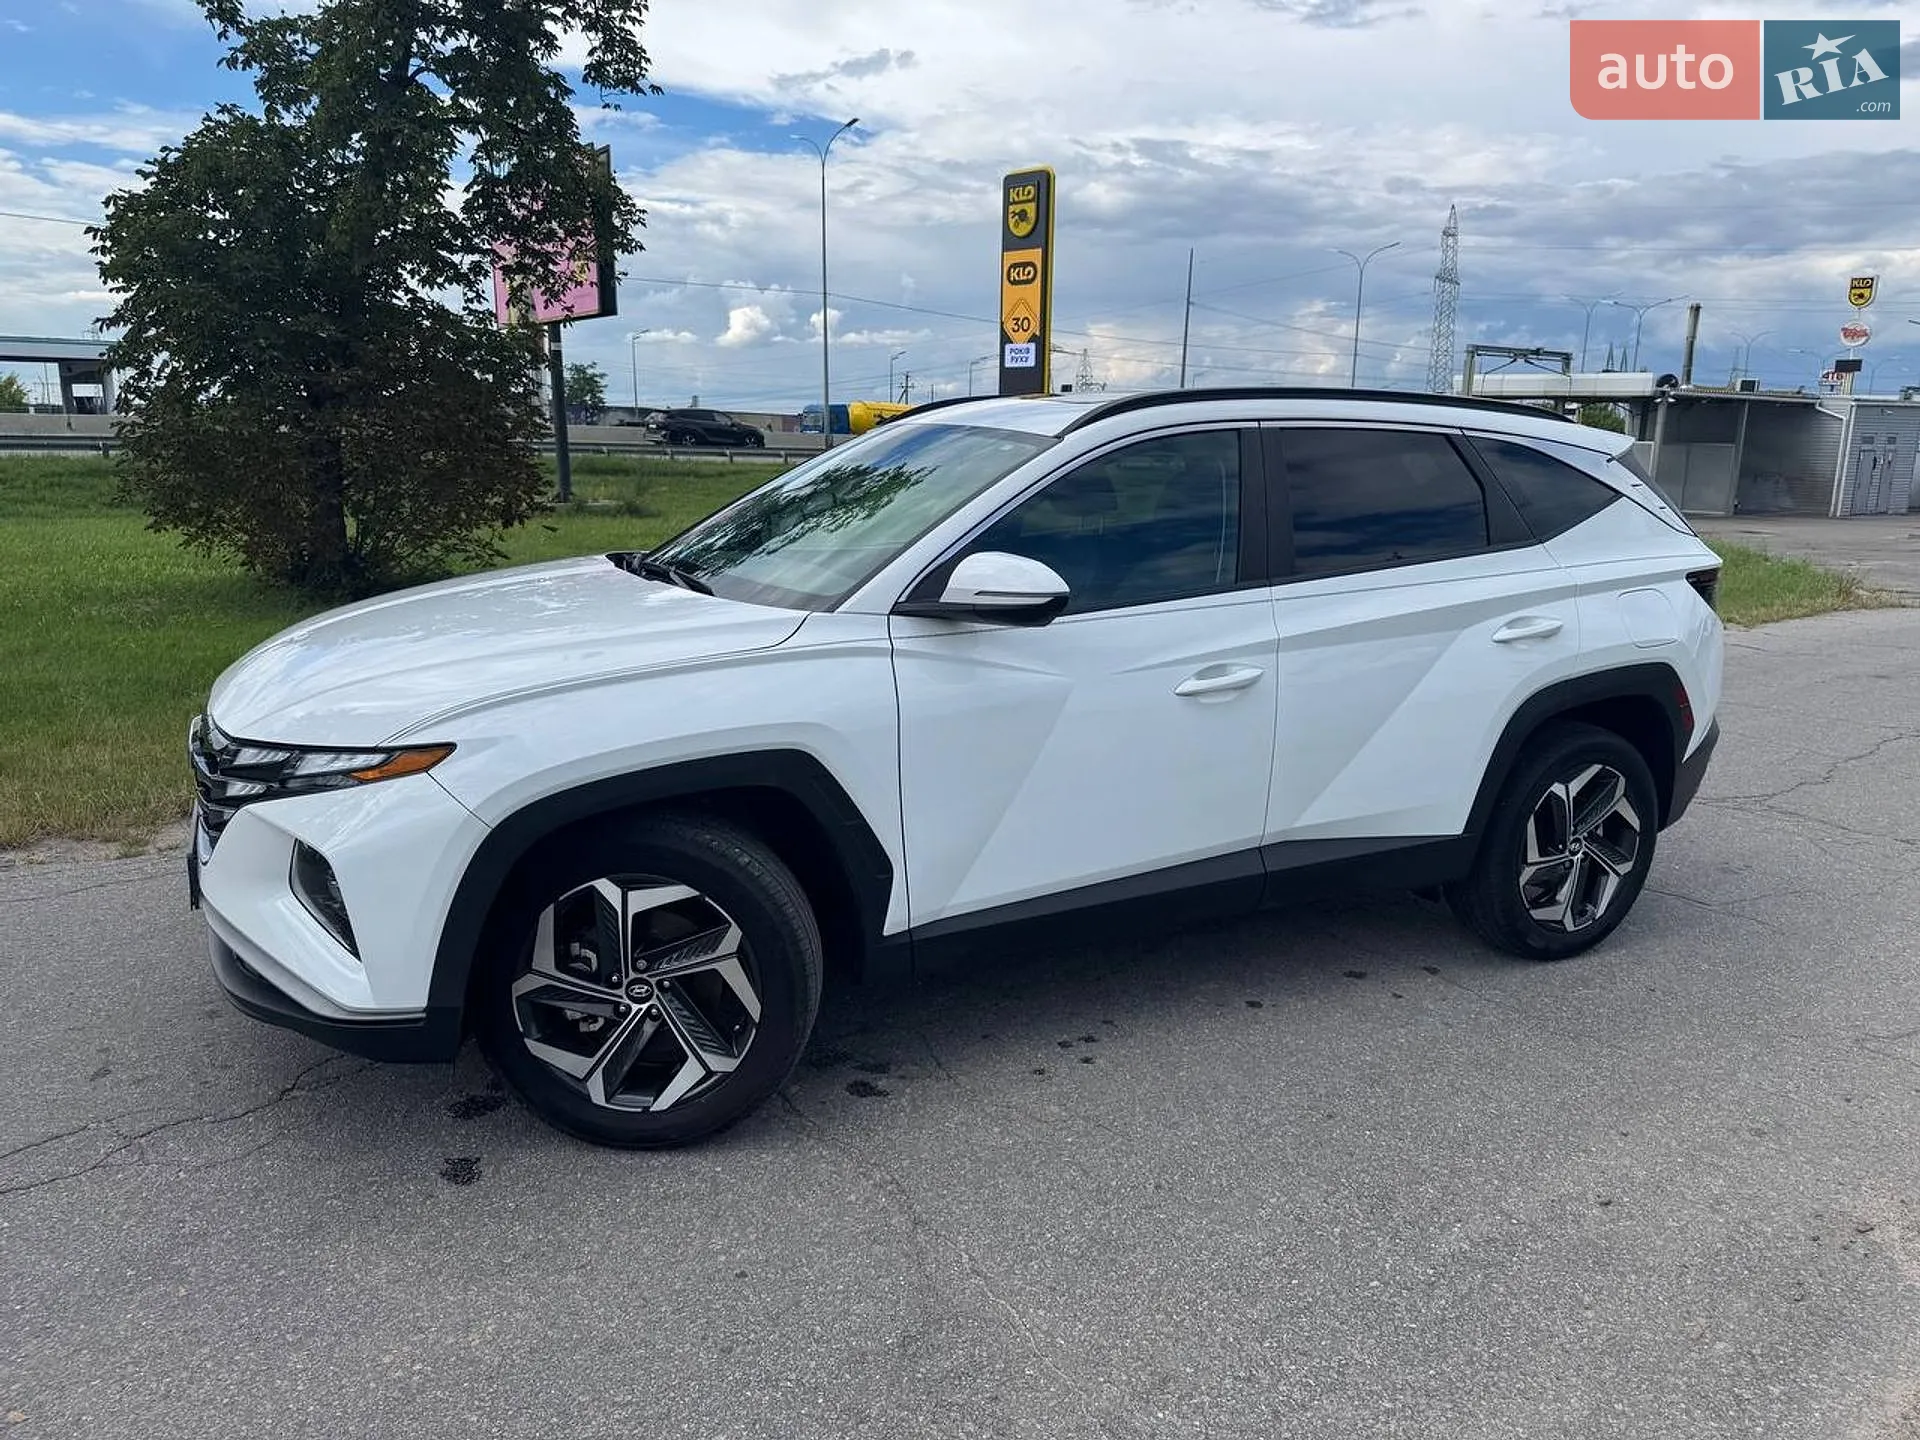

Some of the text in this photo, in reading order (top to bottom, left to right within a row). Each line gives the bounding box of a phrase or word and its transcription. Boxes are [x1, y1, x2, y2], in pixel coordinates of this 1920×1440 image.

[1009, 185, 1035, 202] KLO
[1010, 266, 1035, 281] KLO
[1012, 316, 1030, 332] 30
